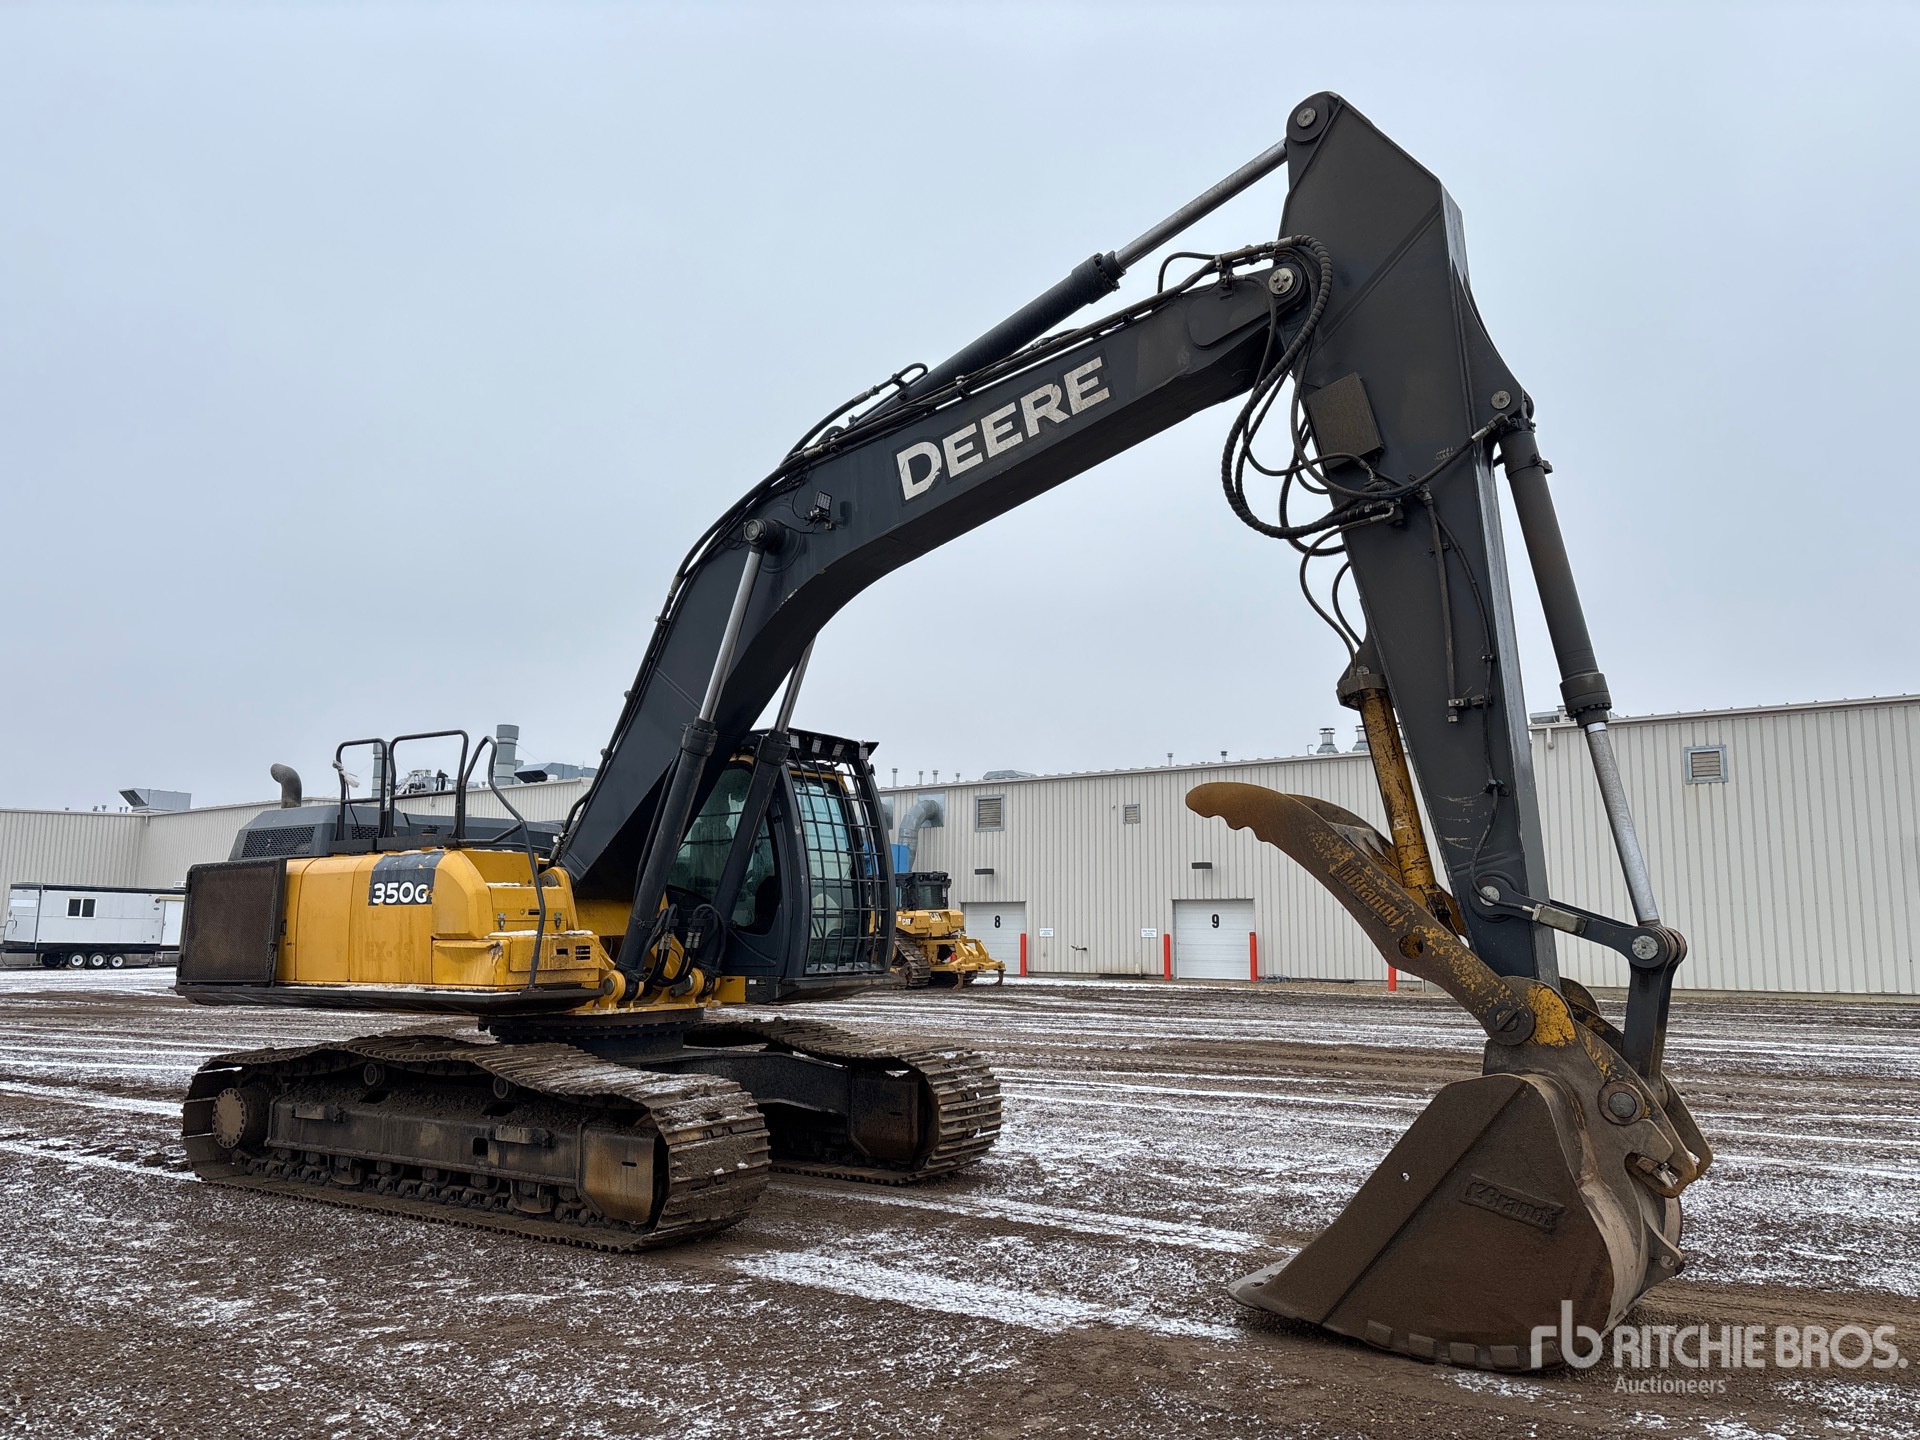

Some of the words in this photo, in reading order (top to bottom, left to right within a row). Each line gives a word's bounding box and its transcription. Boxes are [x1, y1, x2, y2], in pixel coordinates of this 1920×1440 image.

[896, 357, 1110, 500] DEERE
[372, 881, 429, 904] 350G
[994, 915, 1001, 929] 8
[1211, 913, 1220, 929] 9
